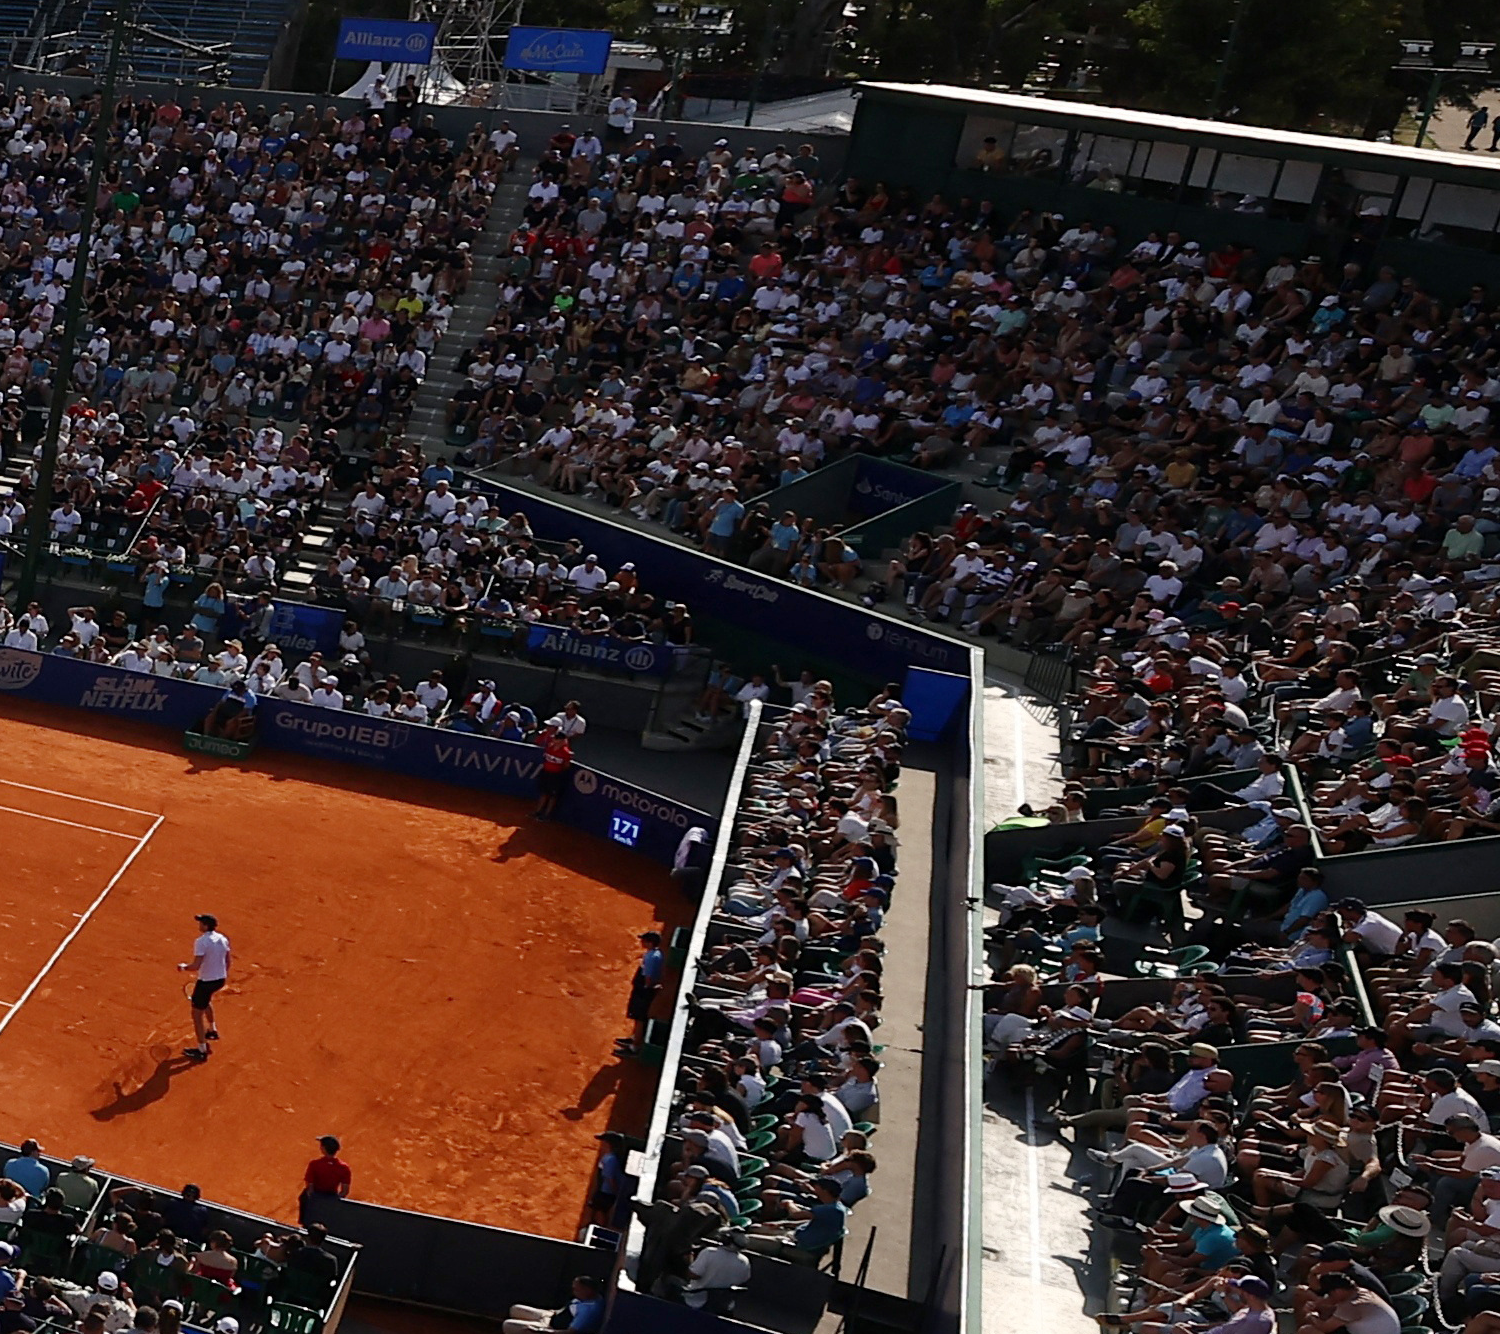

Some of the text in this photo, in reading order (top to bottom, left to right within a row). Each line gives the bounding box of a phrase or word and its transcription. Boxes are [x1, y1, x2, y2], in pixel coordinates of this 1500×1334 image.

[344, 31, 402, 49] Allianz
[723, 574, 779, 603] SportClub
[542, 634, 621, 662] Allianz
[884, 628, 948, 661] tennium
[79, 689, 169, 711] NETFLIX
[602, 783, 688, 828] motorola
[612, 816, 640, 838] 171
